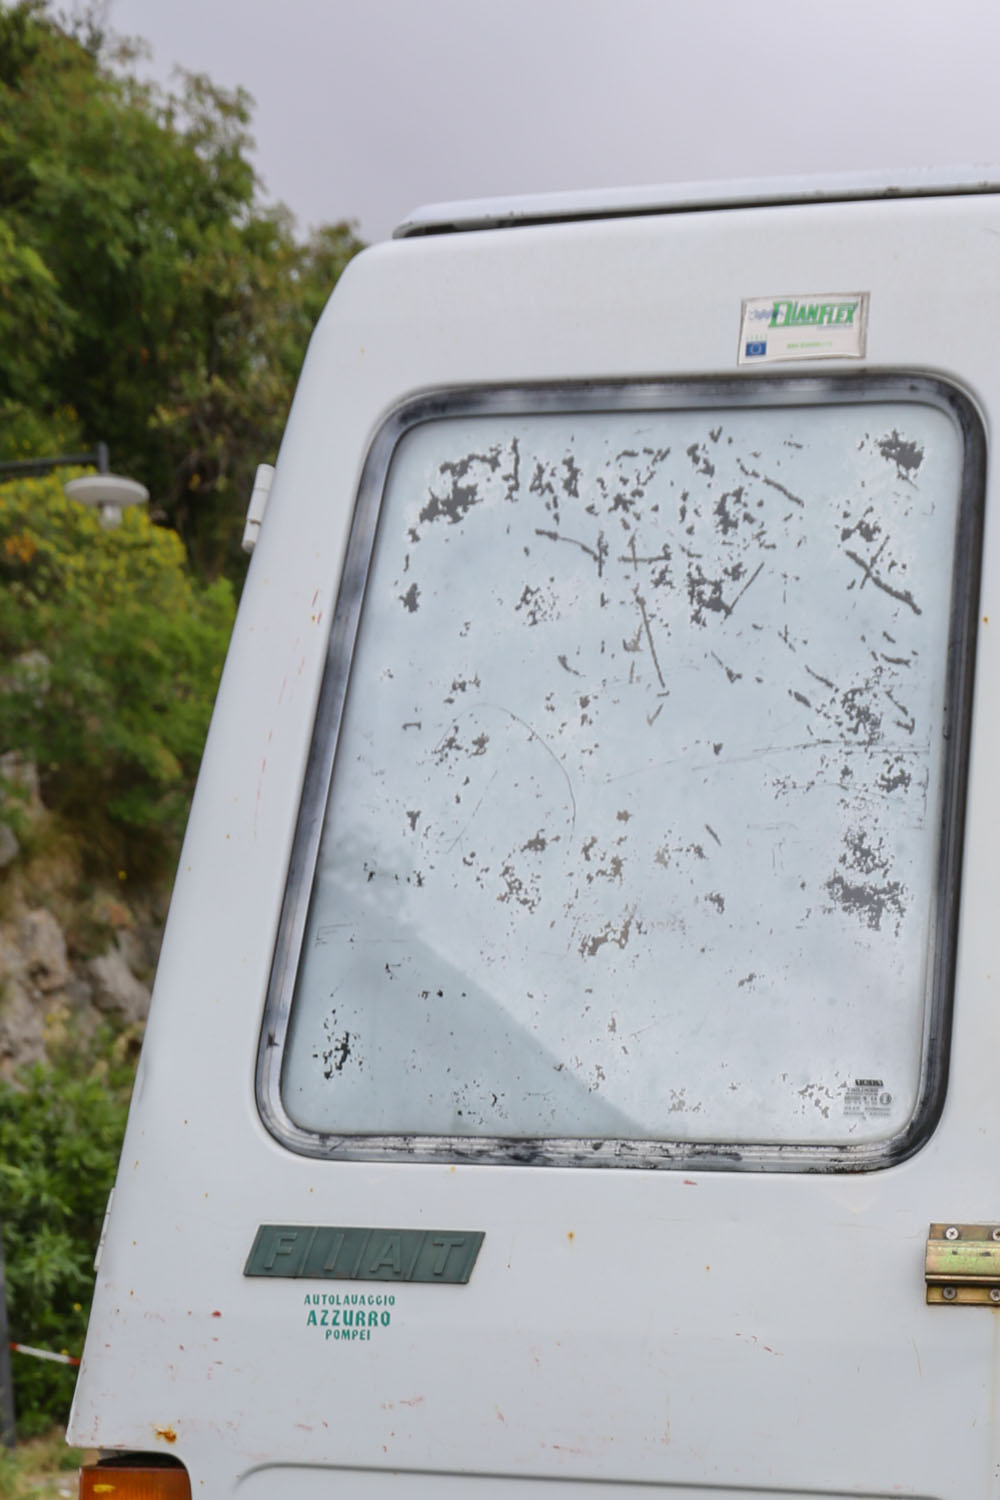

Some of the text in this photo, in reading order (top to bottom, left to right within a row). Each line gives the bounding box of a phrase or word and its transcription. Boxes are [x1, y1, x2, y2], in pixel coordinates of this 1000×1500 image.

[263, 1231, 465, 1277] FIAT
[304, 1294, 396, 1306] AUTOLAVAGGIO
[306, 1309, 391, 1327] AZZURRO
[325, 1328, 371, 1340] POMPEI
